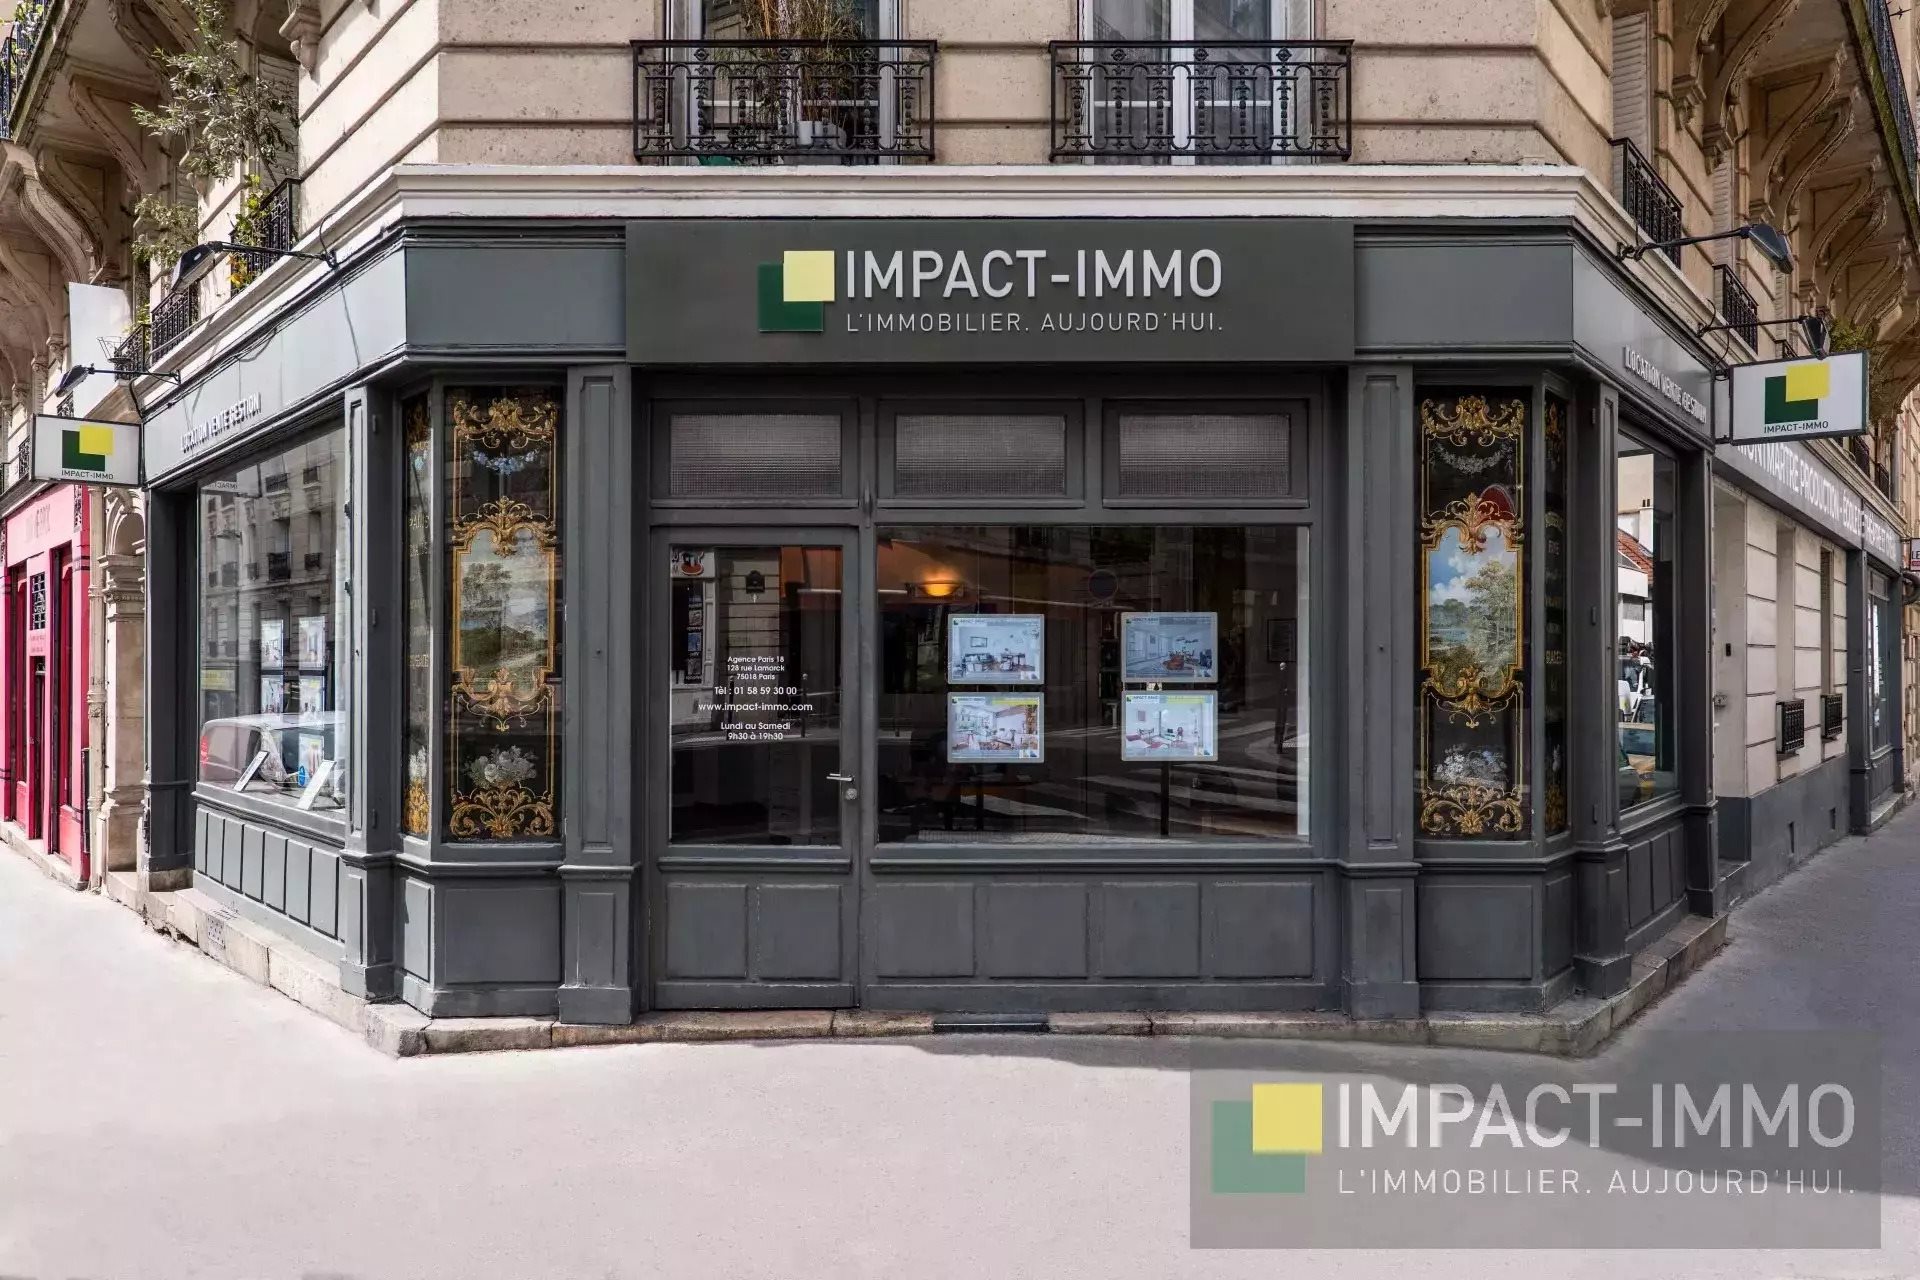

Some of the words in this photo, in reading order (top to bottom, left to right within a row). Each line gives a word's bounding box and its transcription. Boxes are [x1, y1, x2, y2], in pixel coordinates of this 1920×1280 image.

[847, 249, 1222, 298] IMPACT-IMMO
[847, 313, 1029, 332] L'IMMOBILIER.
[1041, 312, 1223, 332] AUJOURD'HUI.
[1624, 345, 1660, 390] LOCATION
[1764, 421, 1829, 433] IMPACT-IMMO
[61, 469, 114, 480] IMPACT-IMMO
[727, 656, 756, 664] Agence
[727, 664, 739, 672] 128
[754, 664, 785, 672] Lamarck
[734, 686, 744, 695] 01
[747, 686, 758, 695] 58
[760, 686, 771, 695] 59
[773, 686, 784, 695] 30
[786, 686, 797, 695] 00
[698, 702, 813, 713] www.impact-immo.com
[720, 721, 743, 730] Lundi
[758, 721, 791, 730] Samedi
[728, 732, 748, 740] 9h30
[749, 731, 756, 740] à
[759, 732, 784, 740] 19h30
